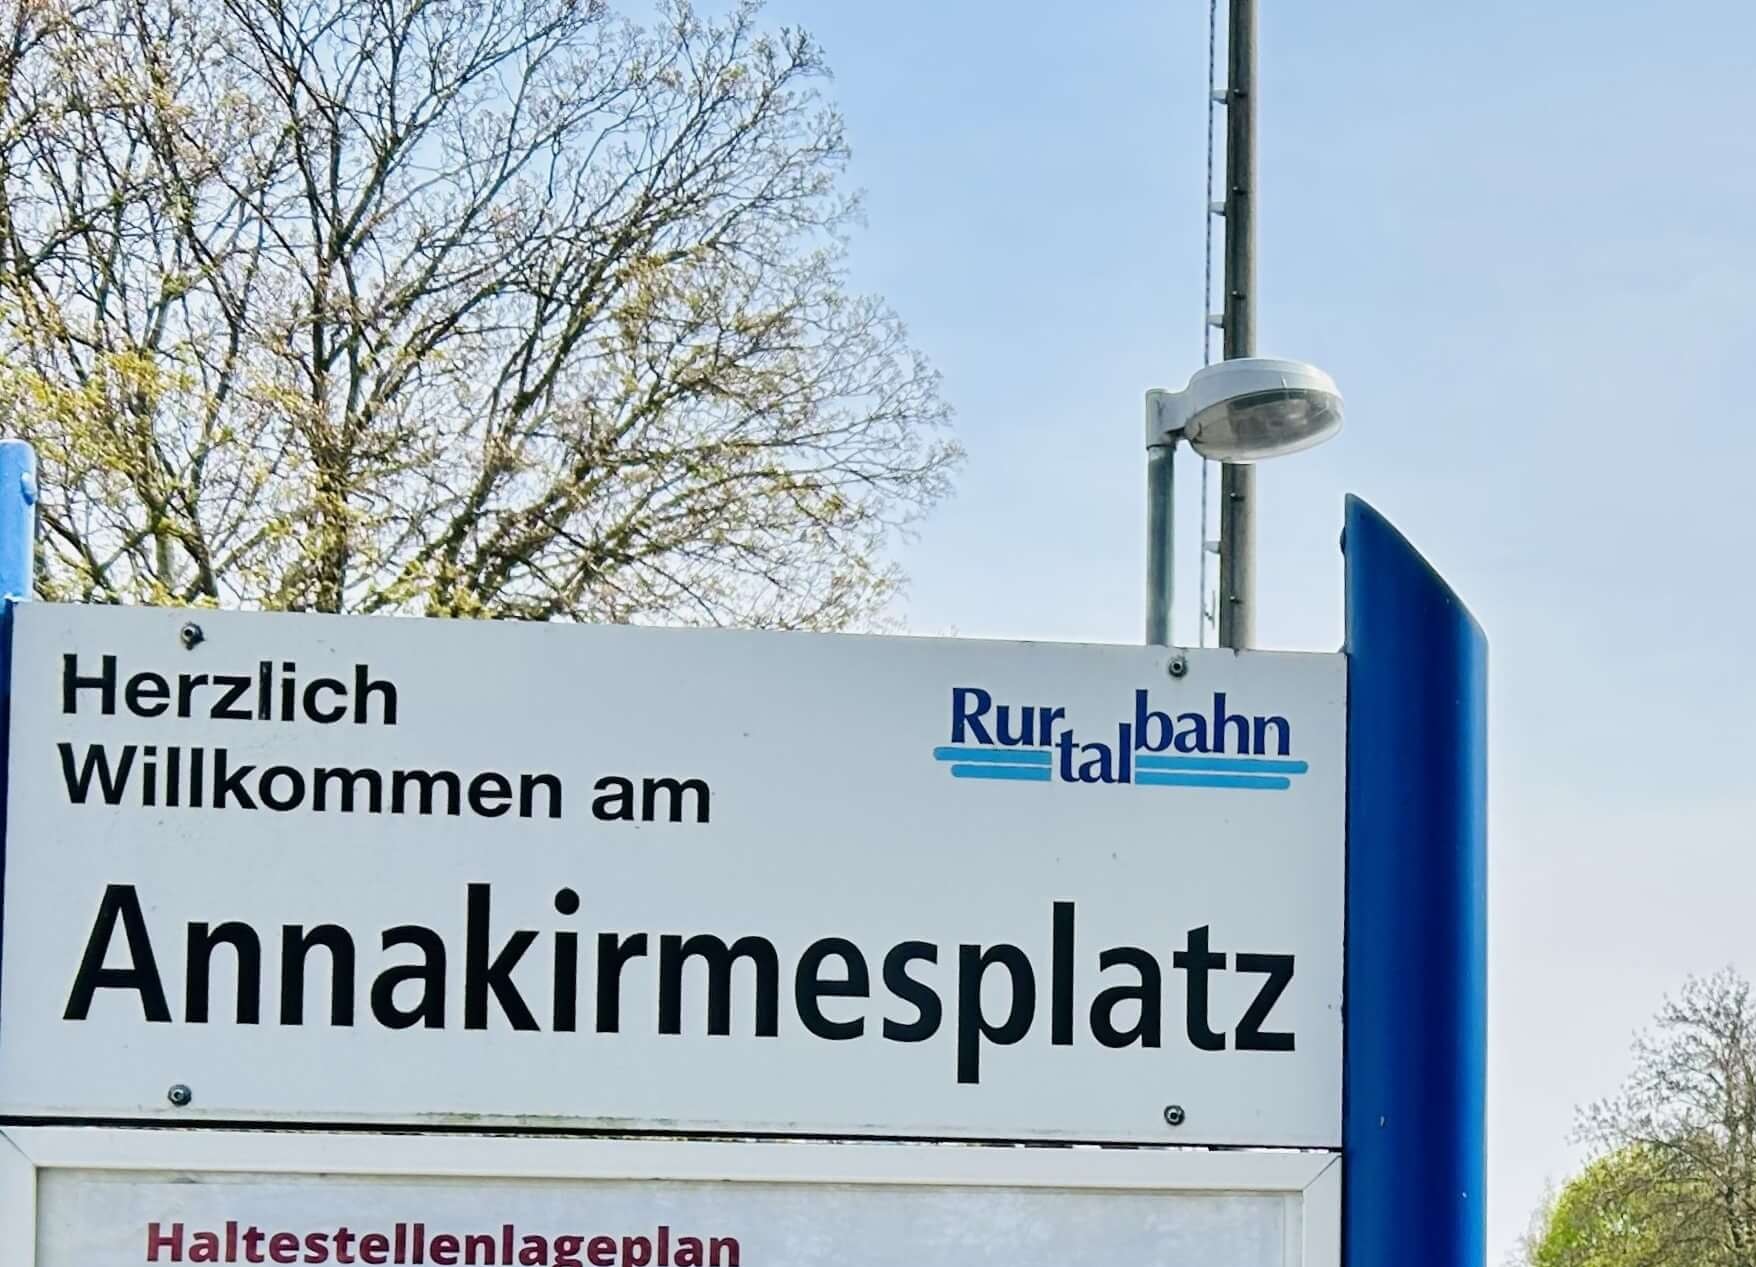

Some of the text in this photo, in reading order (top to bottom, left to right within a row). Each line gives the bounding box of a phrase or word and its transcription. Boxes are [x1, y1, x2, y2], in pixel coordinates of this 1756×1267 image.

[62, 653, 398, 725] Herzlich
[951, 687, 1290, 784] Rurtalbahn
[57, 742, 709, 823] Willkommen am
[62, 882, 1295, 1084] Annakirmesplatz
